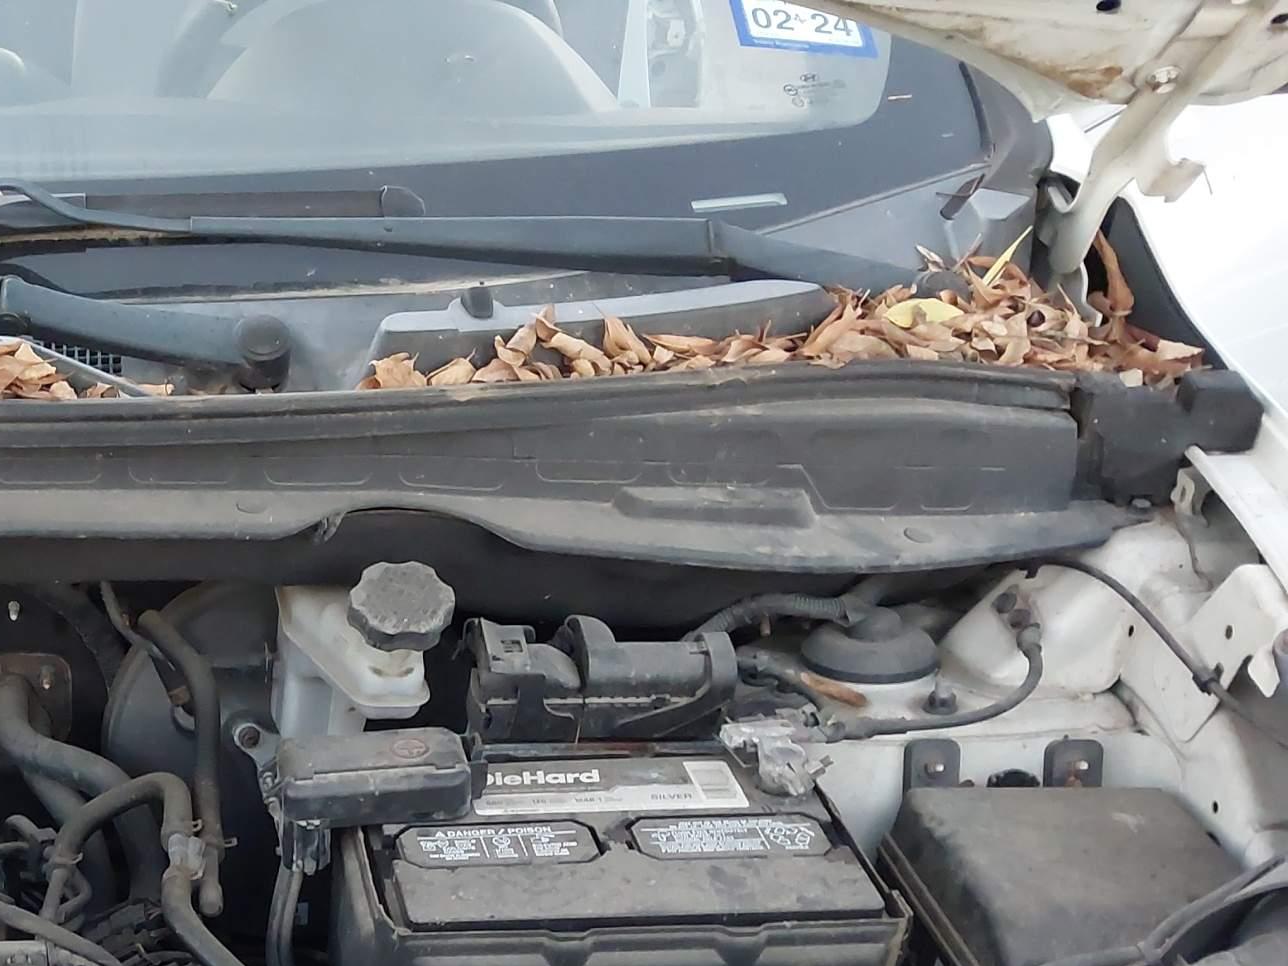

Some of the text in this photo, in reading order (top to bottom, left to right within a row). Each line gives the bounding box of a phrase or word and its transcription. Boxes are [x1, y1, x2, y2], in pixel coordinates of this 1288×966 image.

[751, 7, 853, 36] 02 24
[447, 827, 497, 838] DANGER
[507, 826, 552, 835] POISON
